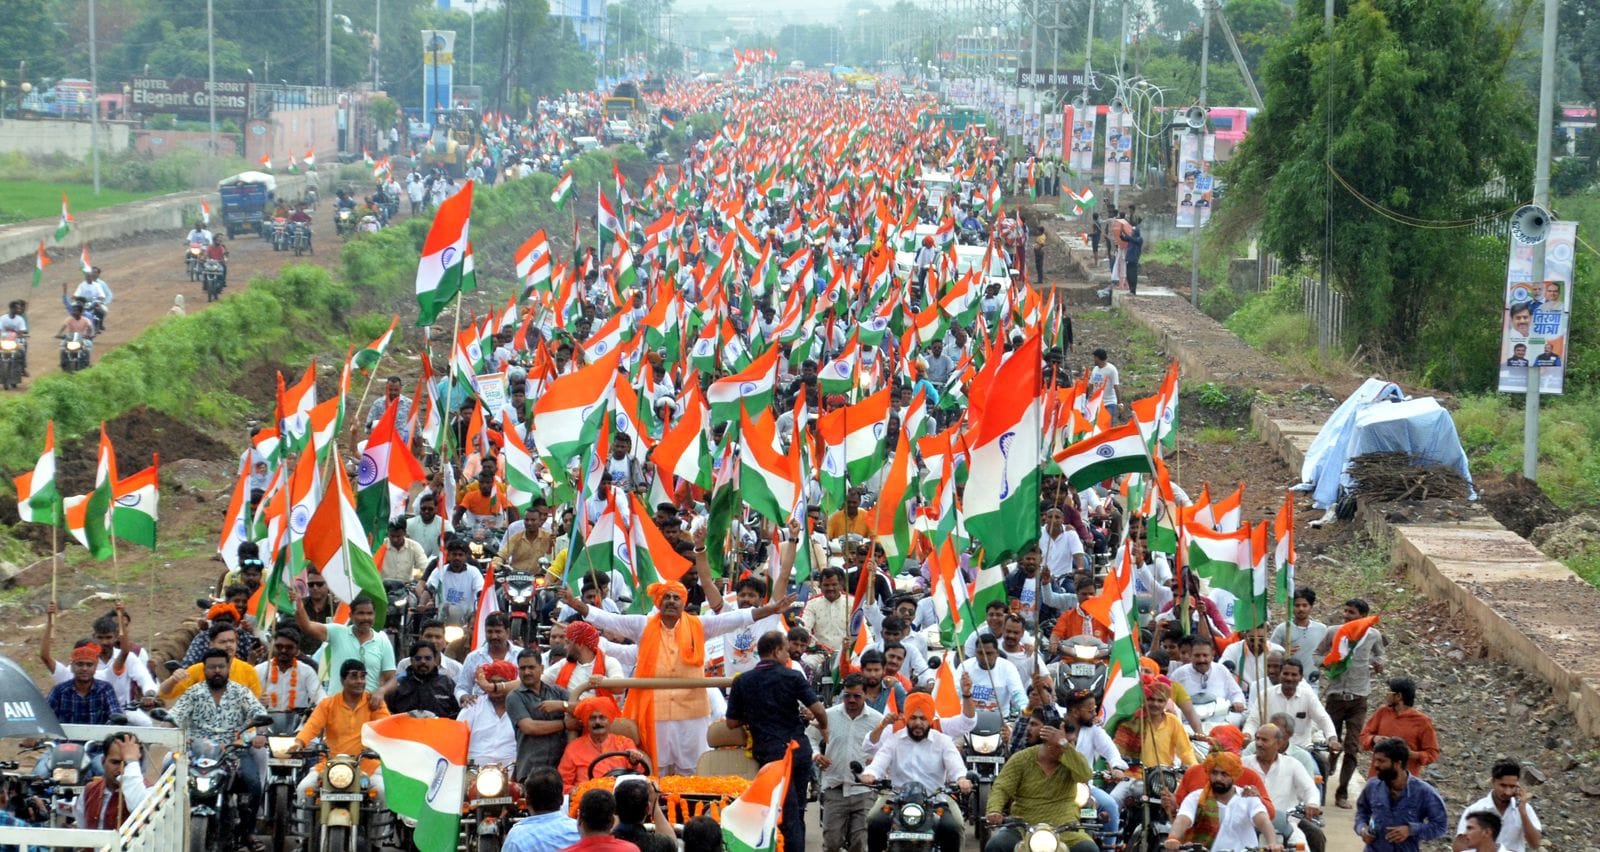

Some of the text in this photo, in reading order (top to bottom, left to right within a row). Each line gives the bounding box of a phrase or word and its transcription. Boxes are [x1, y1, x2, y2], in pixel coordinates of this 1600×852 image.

[133, 79, 246, 92] HOTEL RESORT
[1048, 74, 1069, 85] RYAL
[133, 89, 246, 108] Elegant Greens
[1533, 309, 1561, 323] तिरंगा
[1533, 323, 1560, 335] यात्रा
[3, 701, 35, 718] ANI
